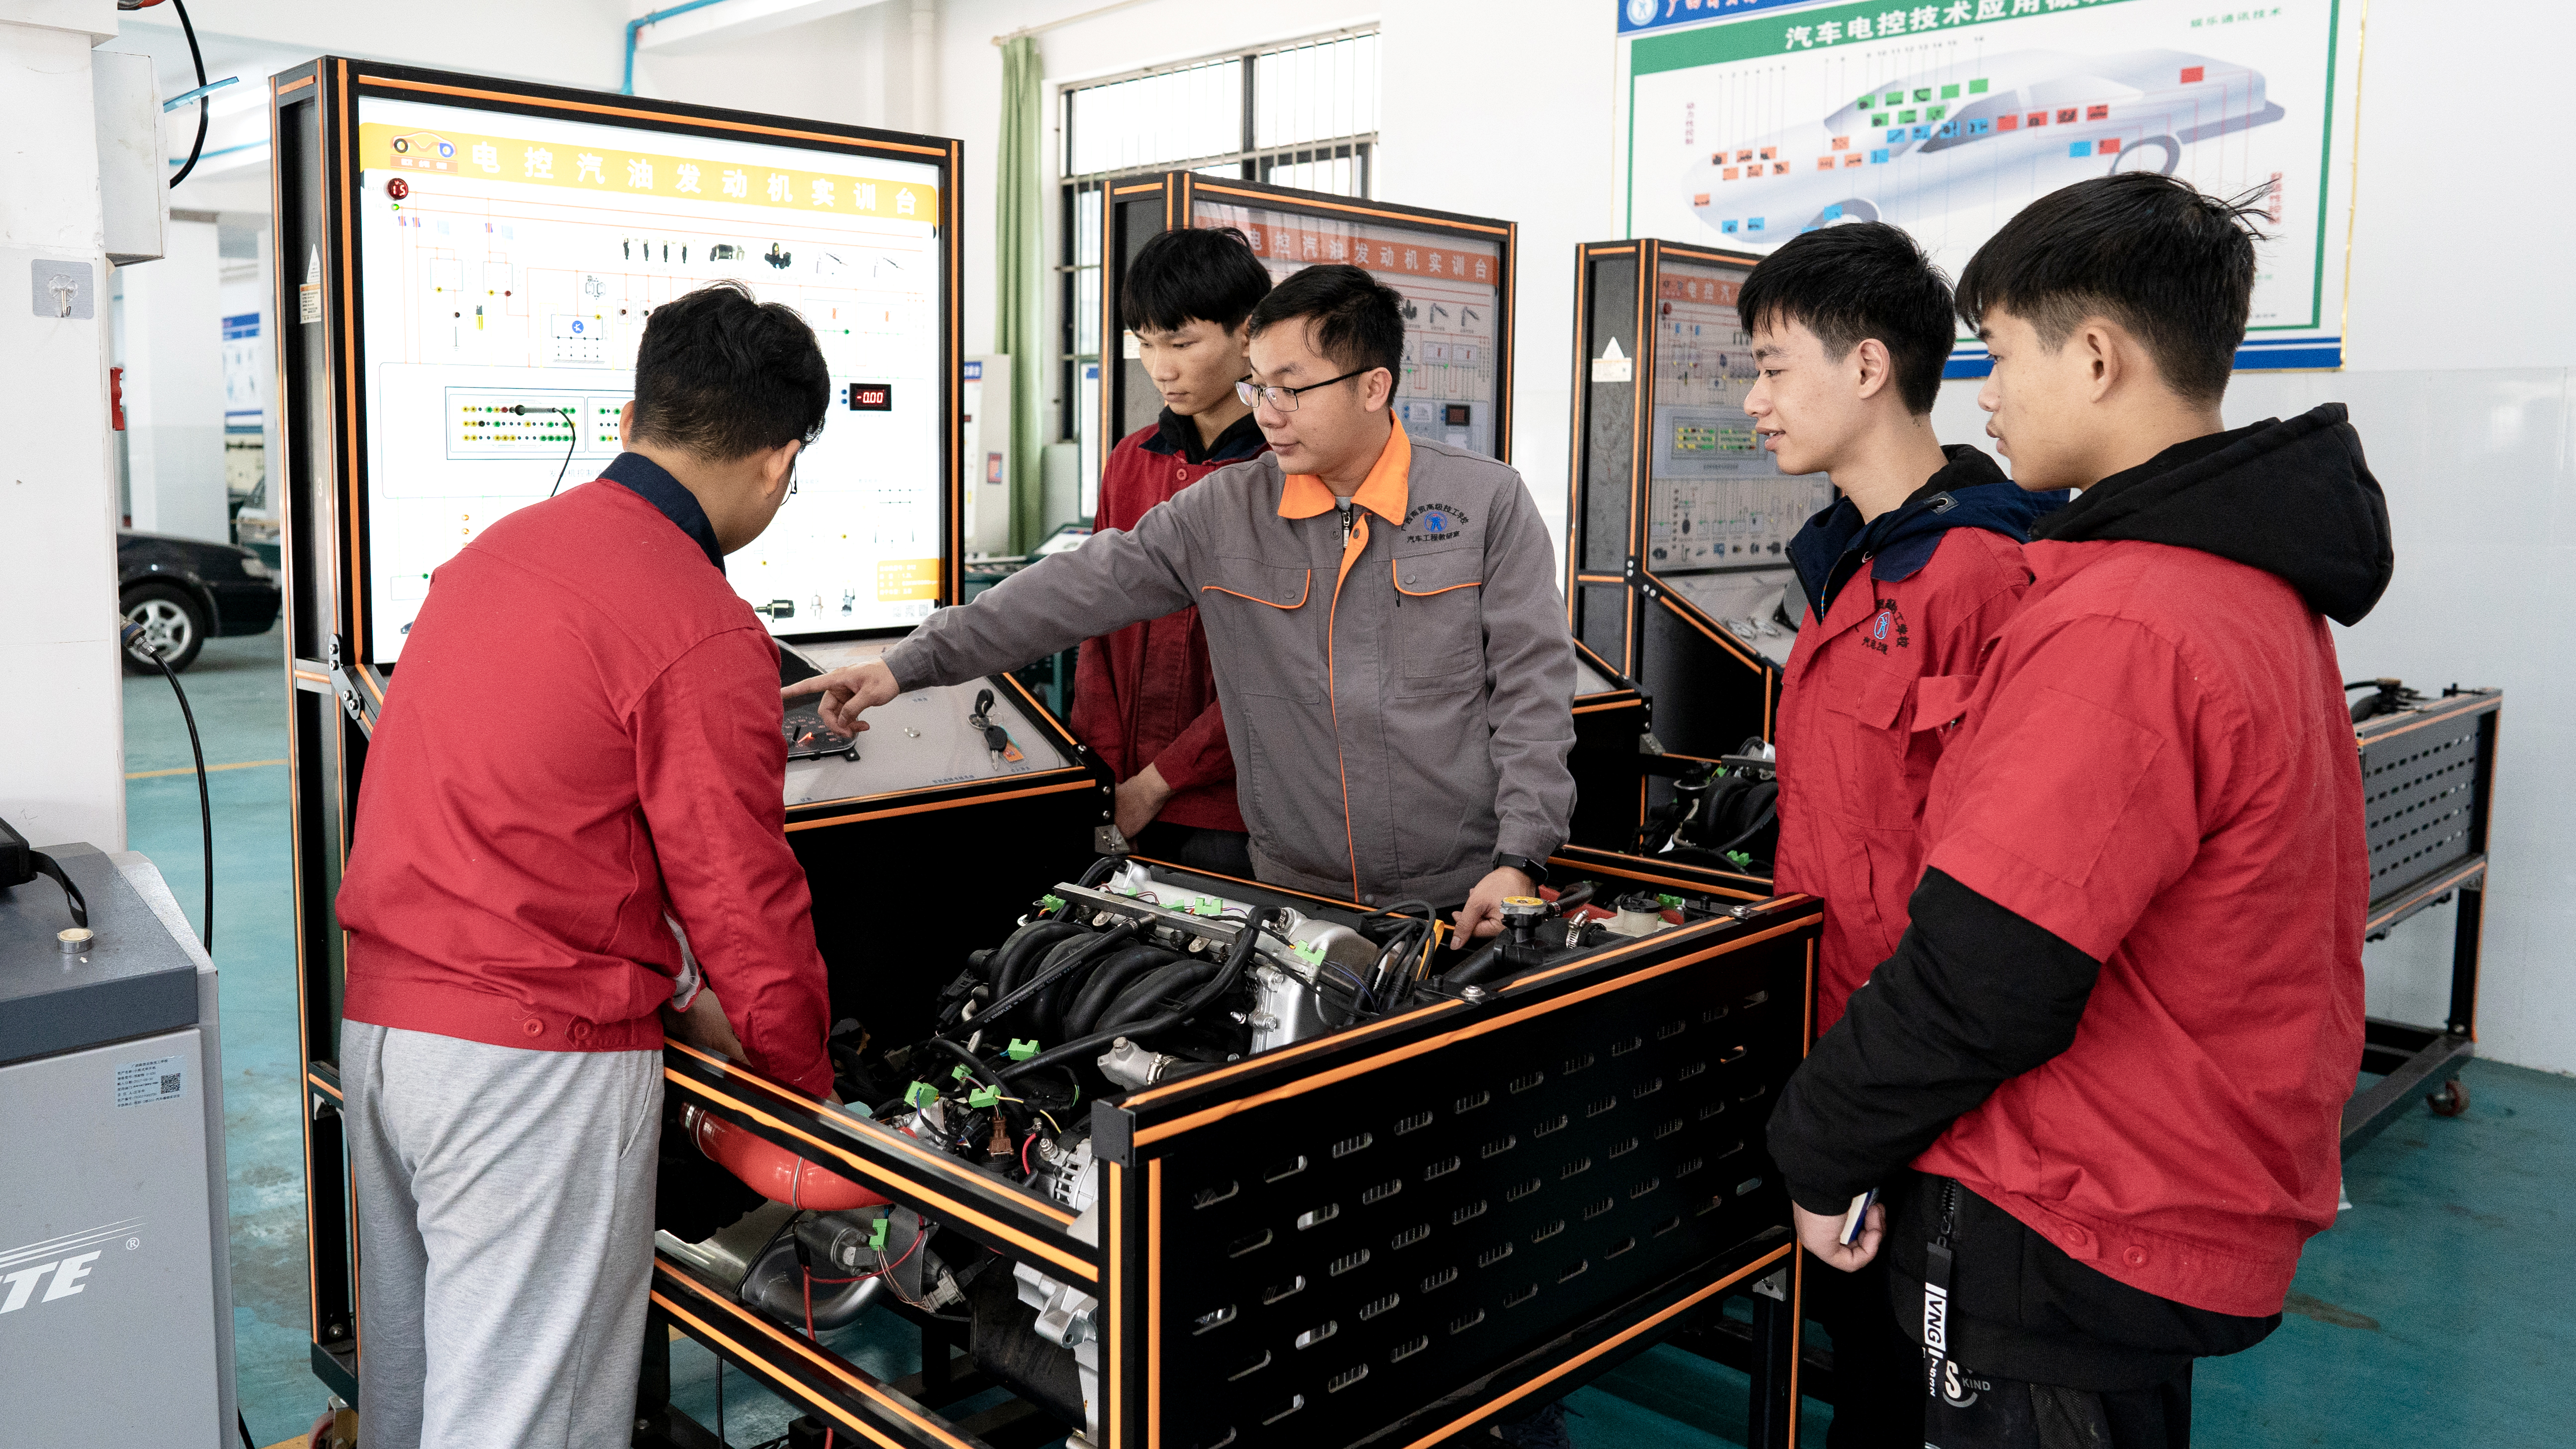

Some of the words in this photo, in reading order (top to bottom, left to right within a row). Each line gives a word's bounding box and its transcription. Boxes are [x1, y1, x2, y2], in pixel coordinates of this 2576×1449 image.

[1785, 0, 2115, 49] 汽车电控技术应用
[472, 141, 917, 216] 电控汽油发动机实训台
[1248, 228, 1487, 280] 电控汽油发动机实训台
[856, 391, 884, 403] -0.00
[1401, 502, 1469, 531] 广西商贸高级技工学校
[1407, 530, 1460, 543] 汽车工程教研室
[991, 1004, 1013, 1019] KINGFLEX
[1019, 990, 1035, 1001] GASOLINE
[0, 1250, 102, 1314] TE
[1927, 1300, 1943, 1345] VNG
[1929, 1358, 1939, 1397] 7532
[1962, 1376, 1990, 1391] KIND
